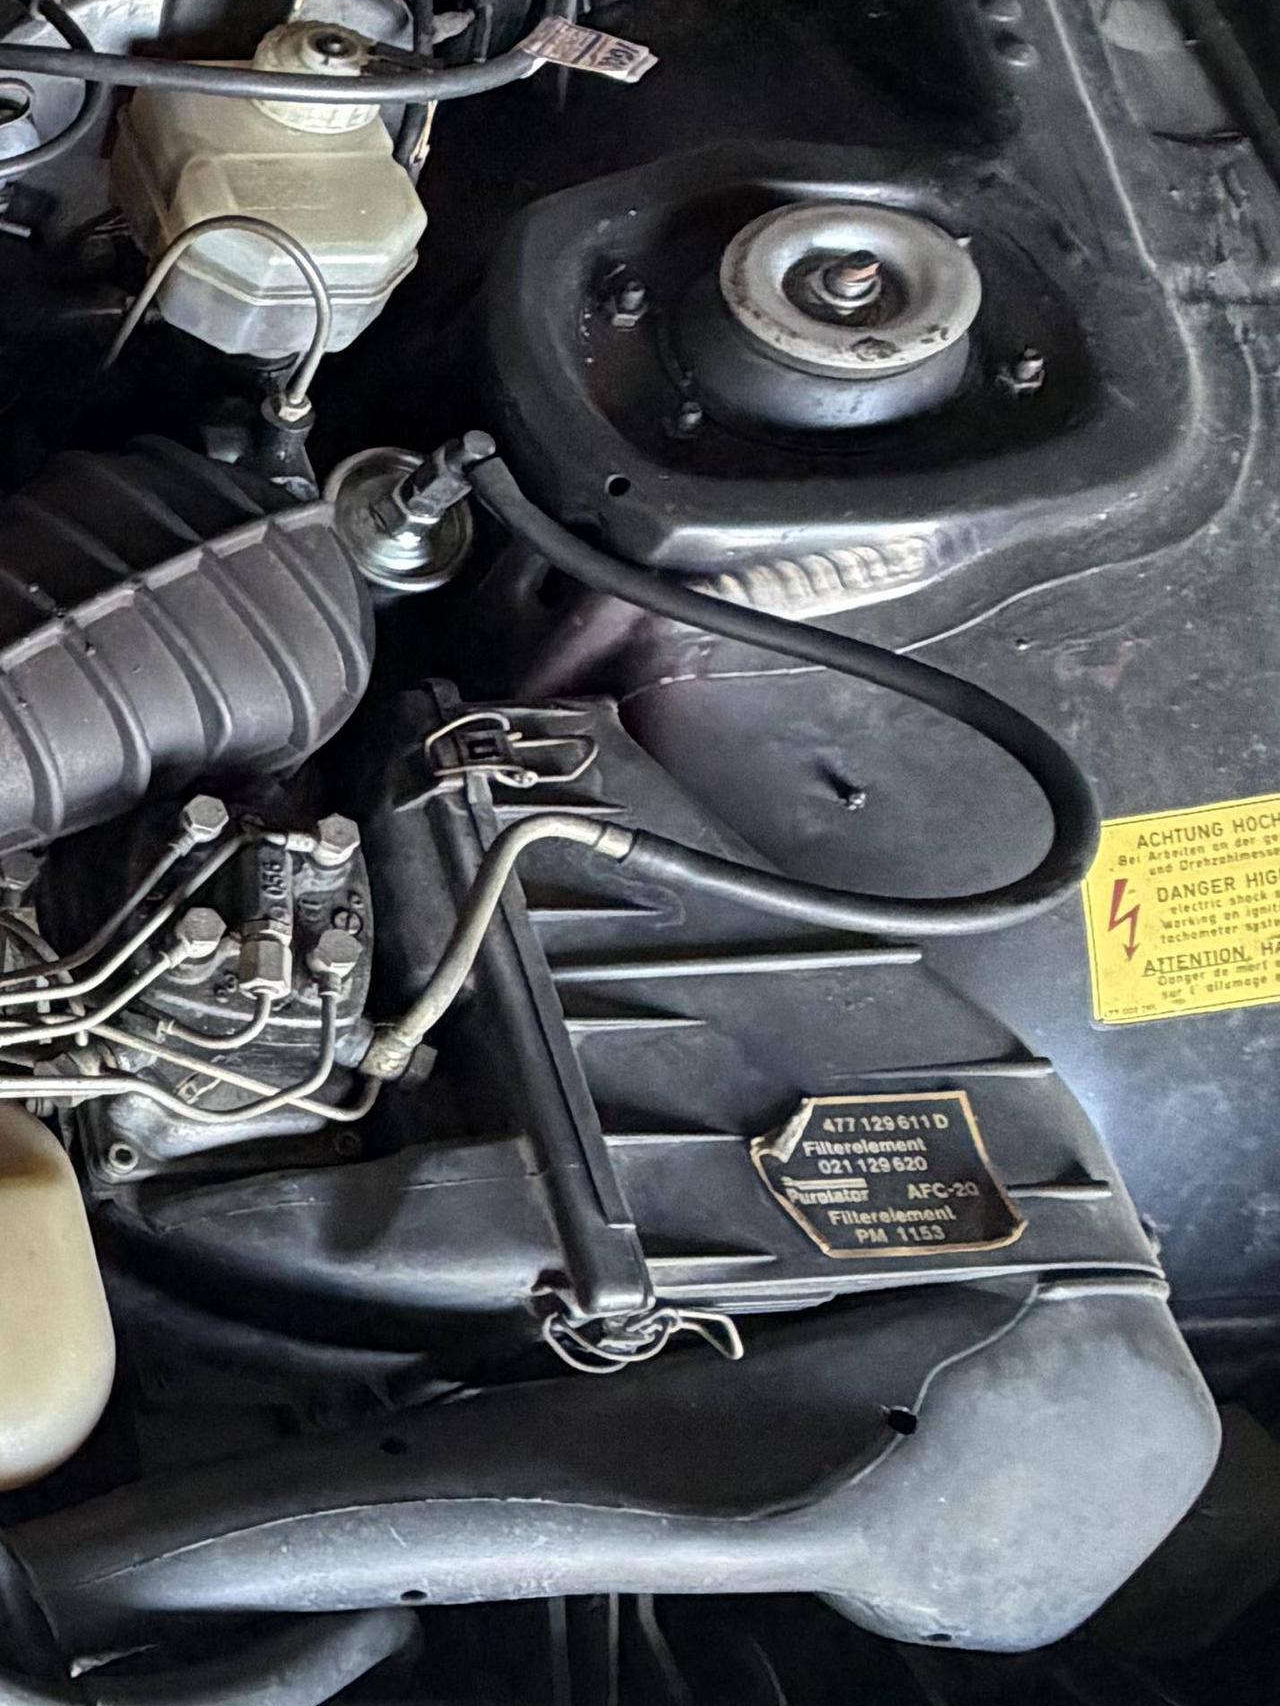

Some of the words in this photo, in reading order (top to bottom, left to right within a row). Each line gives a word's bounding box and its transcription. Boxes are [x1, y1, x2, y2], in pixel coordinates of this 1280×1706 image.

[1137, 822, 1224, 849] ACHTUNG
[1118, 855, 1141, 866] Bei
[1148, 845, 1206, 861] Arbeiten
[1234, 836, 1255, 848] der
[1157, 877, 1237, 902] DANGER
[1245, 868, 1280, 889] HIG
[1170, 899, 1222, 914] electric
[1229, 890, 1268, 906] shock
[1157, 971, 1205, 986] Danger
[822, 1117, 856, 1132] 477
[860, 1115, 895, 1132] 129
[898, 1114, 931, 1129] 611
[932, 1114, 949, 1129] D
[802, 1136, 928, 1157] Filterelement
[817, 1159, 854, 1174] 021
[857, 1158, 892, 1173] 129
[892, 1156, 929, 1172] 620
[785, 1187, 870, 1205] Purolator
[826, 1205, 958, 1226] Filterelement
[855, 1228, 888, 1244] PM
[896, 1225, 947, 1242] 1153
